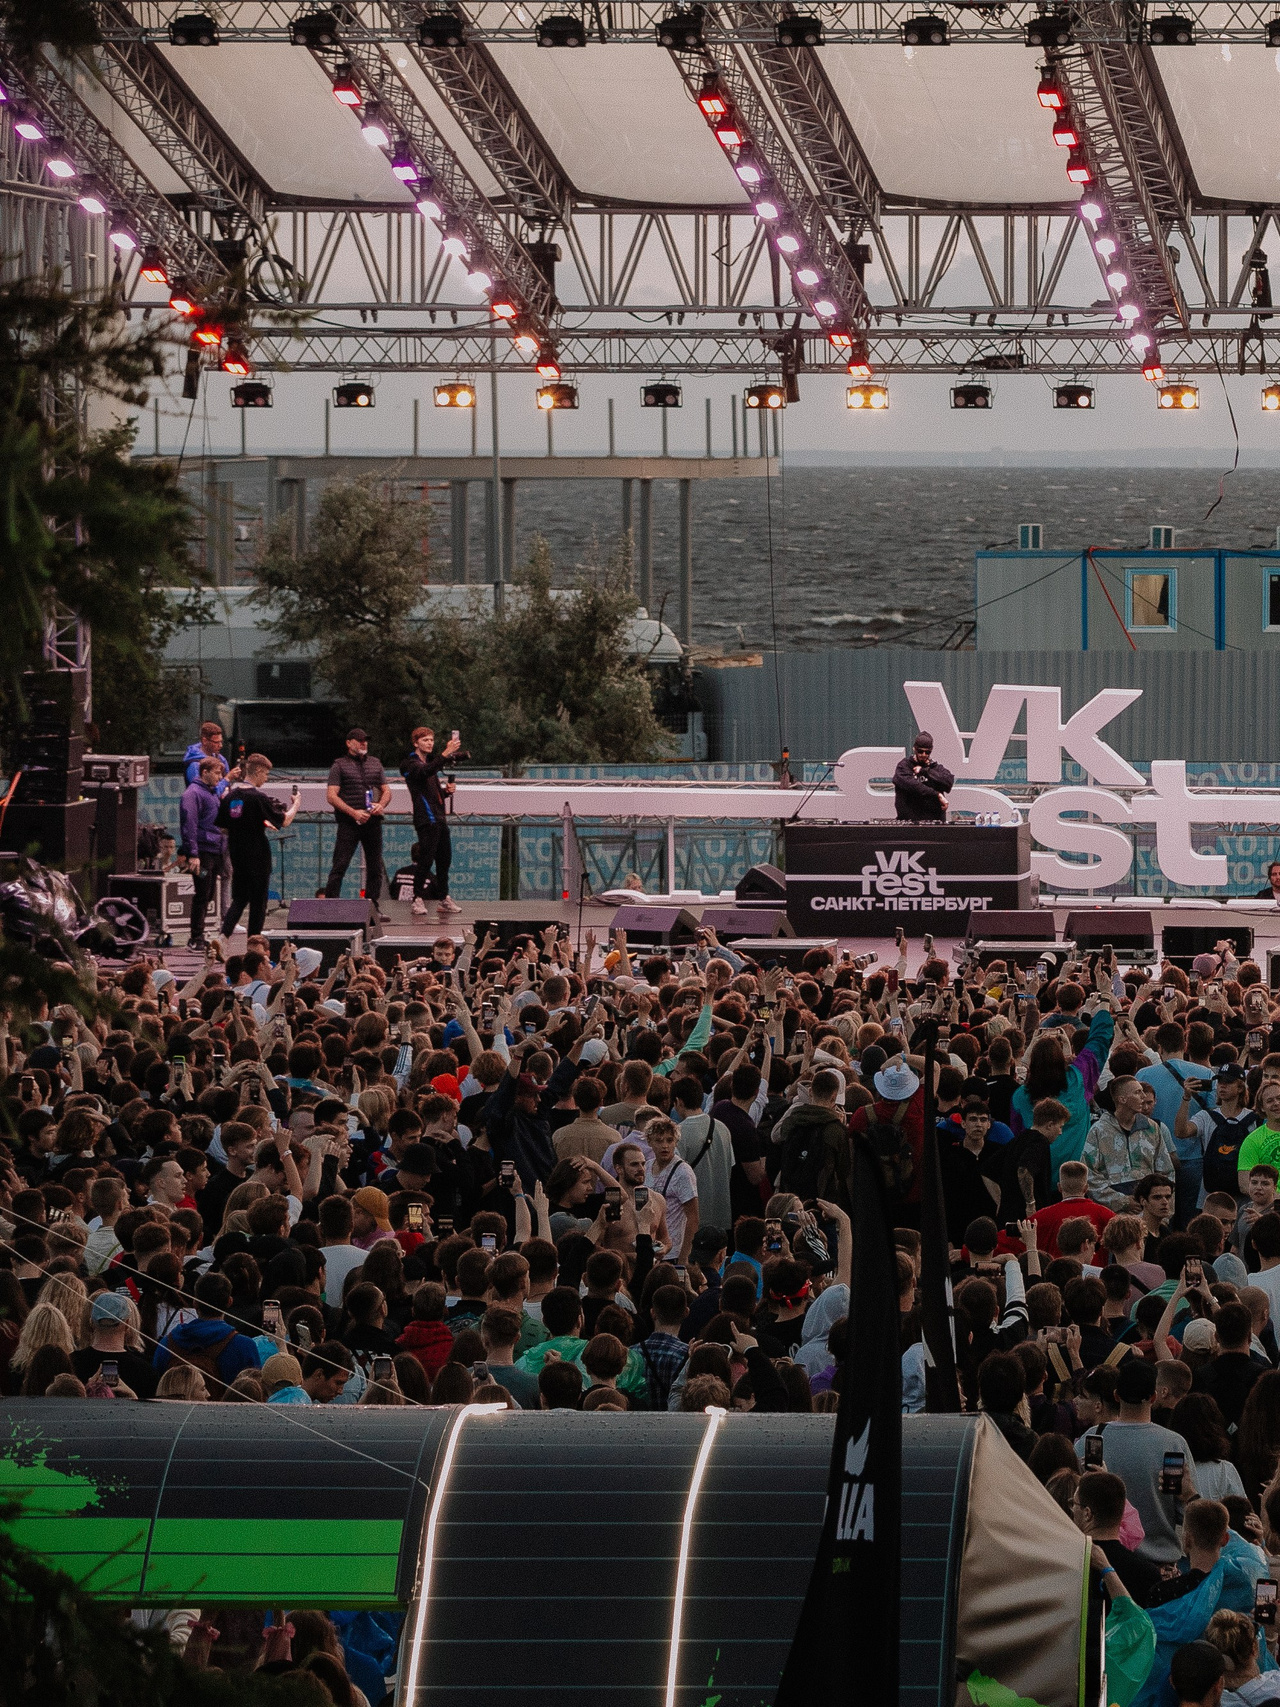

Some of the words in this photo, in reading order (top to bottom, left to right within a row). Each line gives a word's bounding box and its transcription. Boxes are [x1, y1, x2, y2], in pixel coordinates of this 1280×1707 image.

[904, 681, 1147, 785] VK
[834, 747, 1227, 889] fst
[875, 851, 926, 873] VK
[861, 865, 945, 896] fest
[810, 896, 993, 912] САНКТ-ПЕТЕРБУРГ
